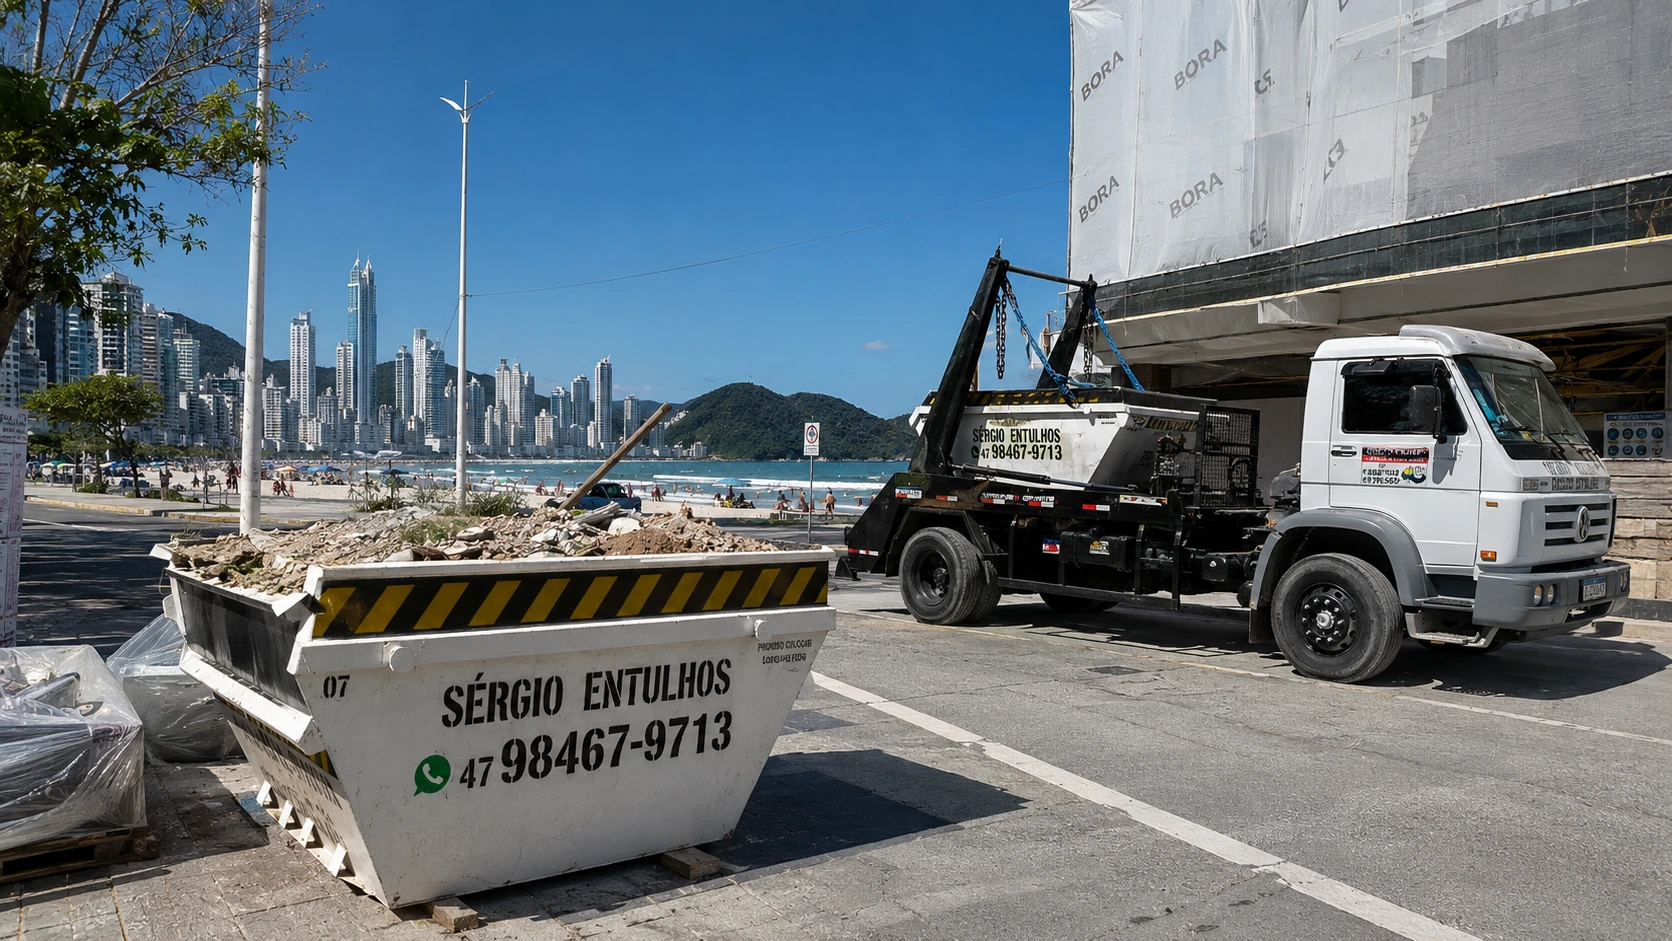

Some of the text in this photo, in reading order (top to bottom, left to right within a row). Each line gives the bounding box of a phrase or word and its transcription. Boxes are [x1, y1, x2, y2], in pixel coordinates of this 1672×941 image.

[1081, 50, 1124, 101] BORA
[1174, 39, 1227, 90] BORA
[1079, 175, 1120, 223] BORA
[1169, 172, 1224, 218] BORA
[973, 425, 1061, 443] SÉRGIO ENTULHOS
[980, 444, 1062, 460] 47 98467-9713
[323, 674, 350, 699] 07
[441, 658, 732, 728] SÉRGIO ENTULHOS
[459, 710, 733, 789] 47 98467-9713
